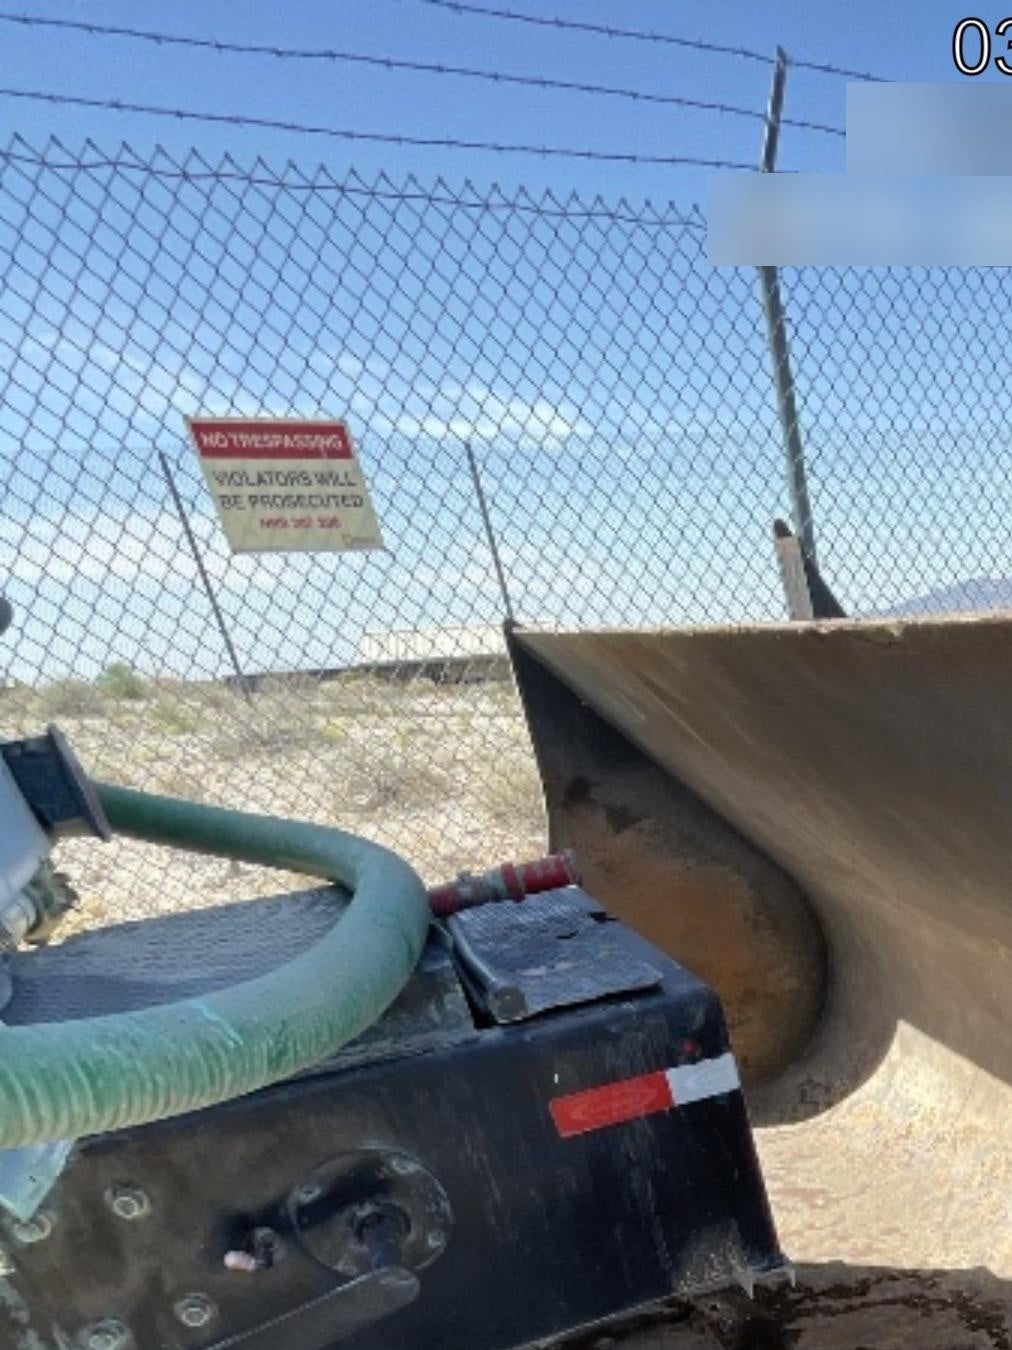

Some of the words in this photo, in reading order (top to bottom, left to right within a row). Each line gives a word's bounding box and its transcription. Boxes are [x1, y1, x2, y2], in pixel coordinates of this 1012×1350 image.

[200, 432, 229, 449] NO
[228, 432, 342, 450] TRESPASSING
[212, 470, 312, 486] VIOLATORS
[313, 470, 357, 486] WILL
[218, 495, 246, 510] BE
[249, 495, 364, 508] PROSECUTED
